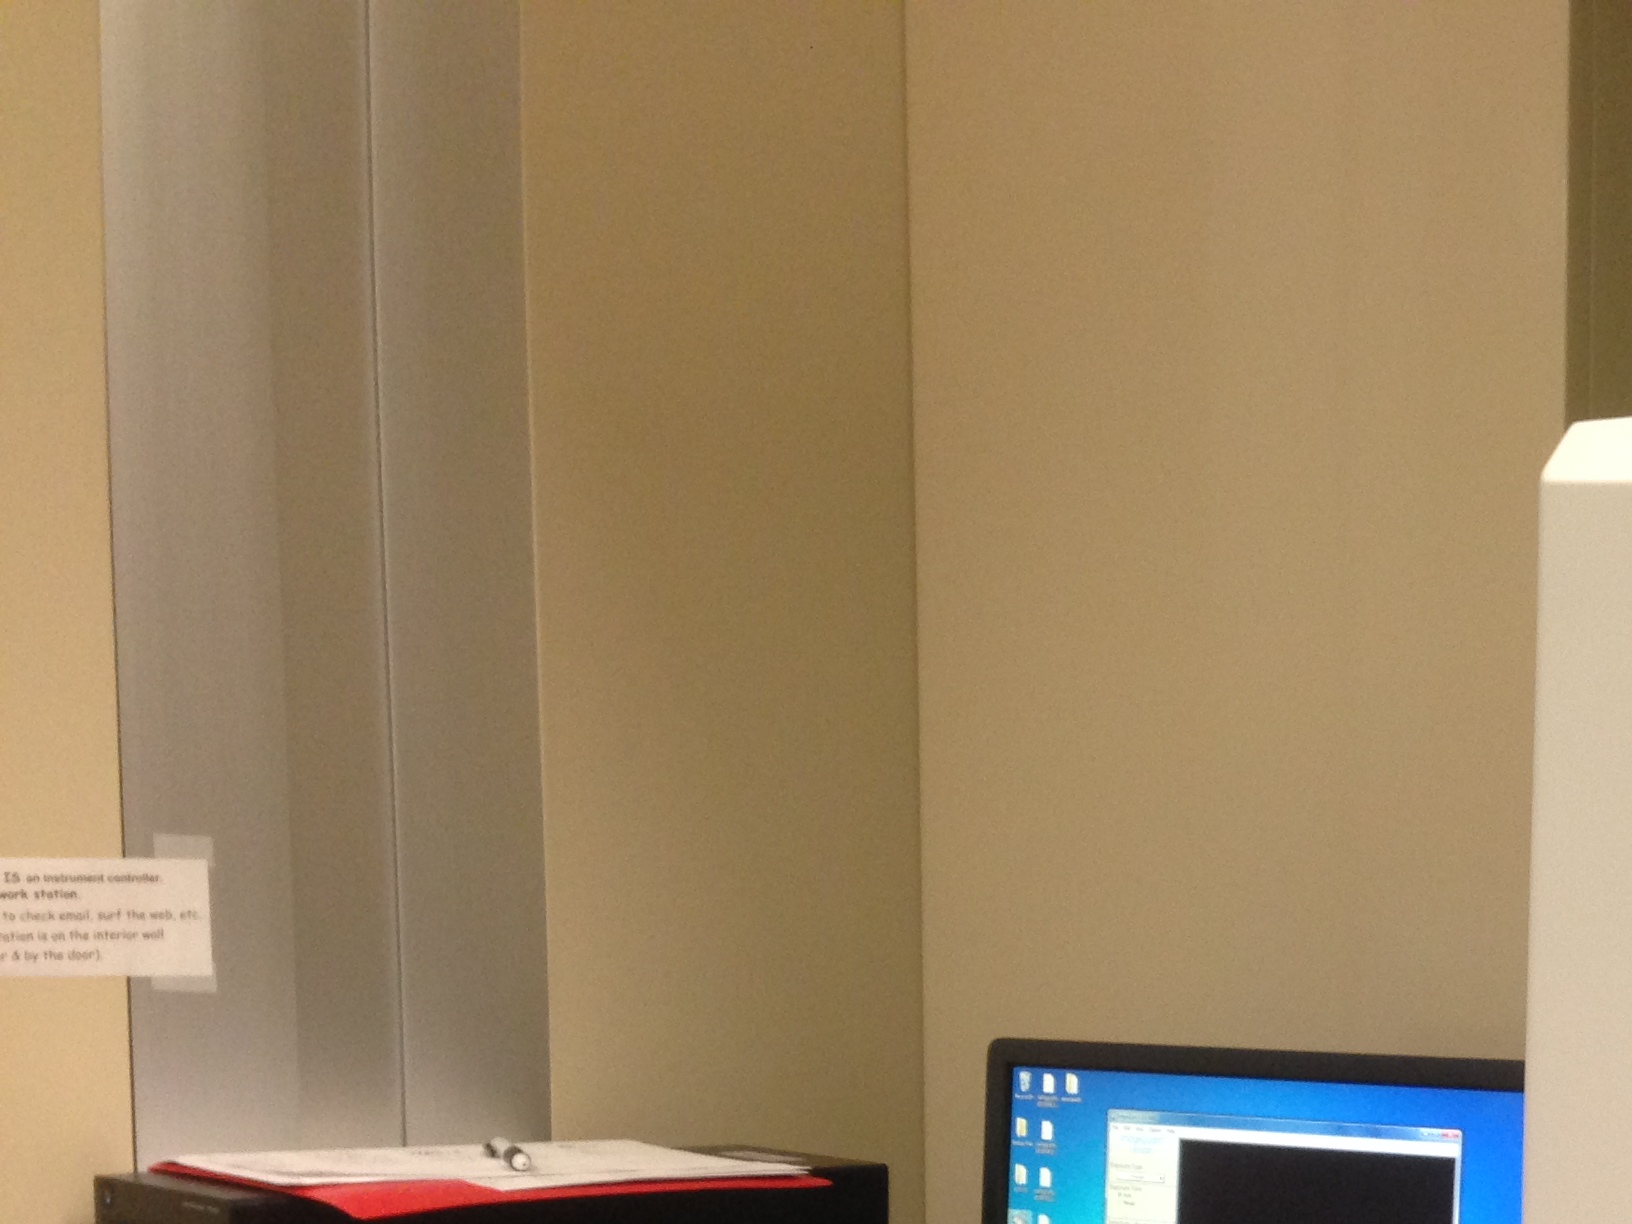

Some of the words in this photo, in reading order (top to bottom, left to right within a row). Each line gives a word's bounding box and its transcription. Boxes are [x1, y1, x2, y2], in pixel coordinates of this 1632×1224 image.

[43, 873, 104, 883] instrument
[19, 909, 55, 921] check
[97, 908, 122, 921] surf
[126, 908, 145, 920] the
[69, 930, 89, 941] the
[93, 929, 138, 941] interior
[43, 950, 64, 961] the
